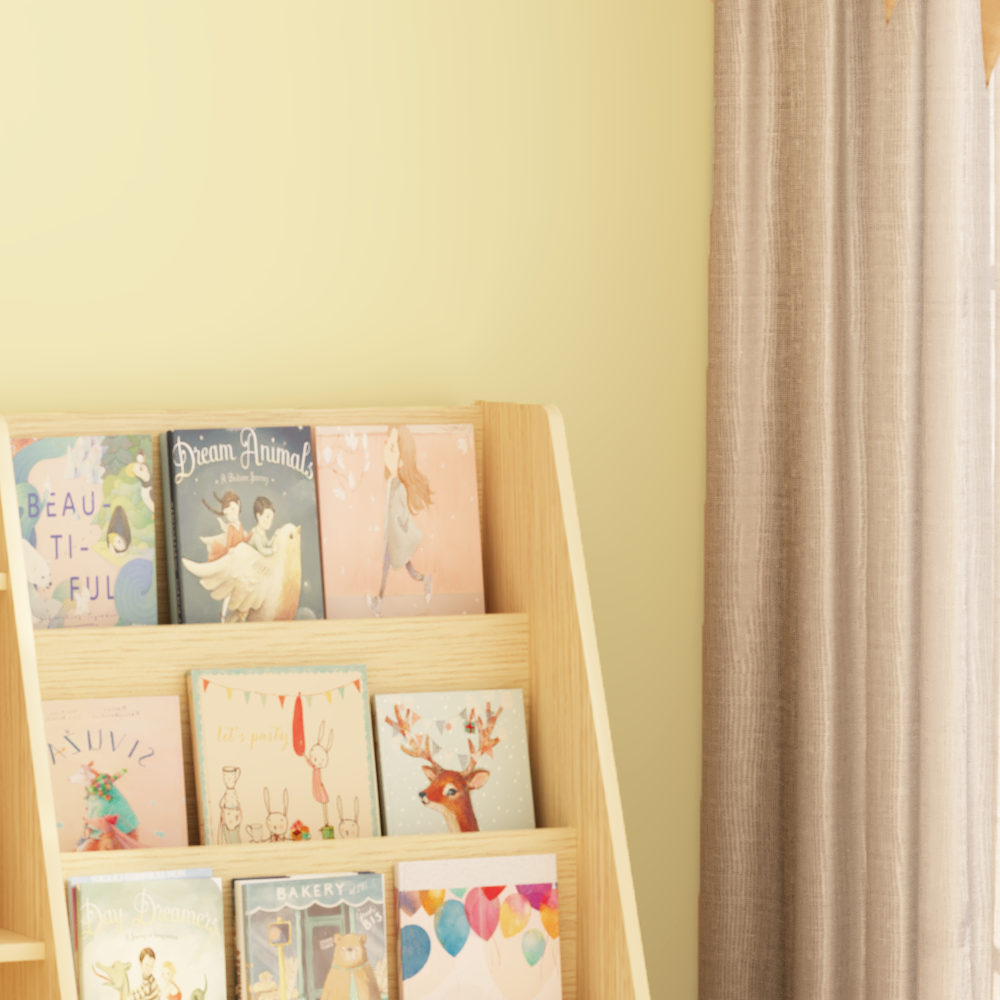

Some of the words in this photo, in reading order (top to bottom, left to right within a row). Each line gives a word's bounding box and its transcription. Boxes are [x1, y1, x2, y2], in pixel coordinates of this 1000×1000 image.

[172, 435, 237, 485] Dream
[239, 426, 314, 480] Animals
[70, 575, 114, 601] FUL
[275, 882, 345, 901] BAKERY
[80, 896, 123, 941] Day
[130, 887, 219, 936] Dreamers
